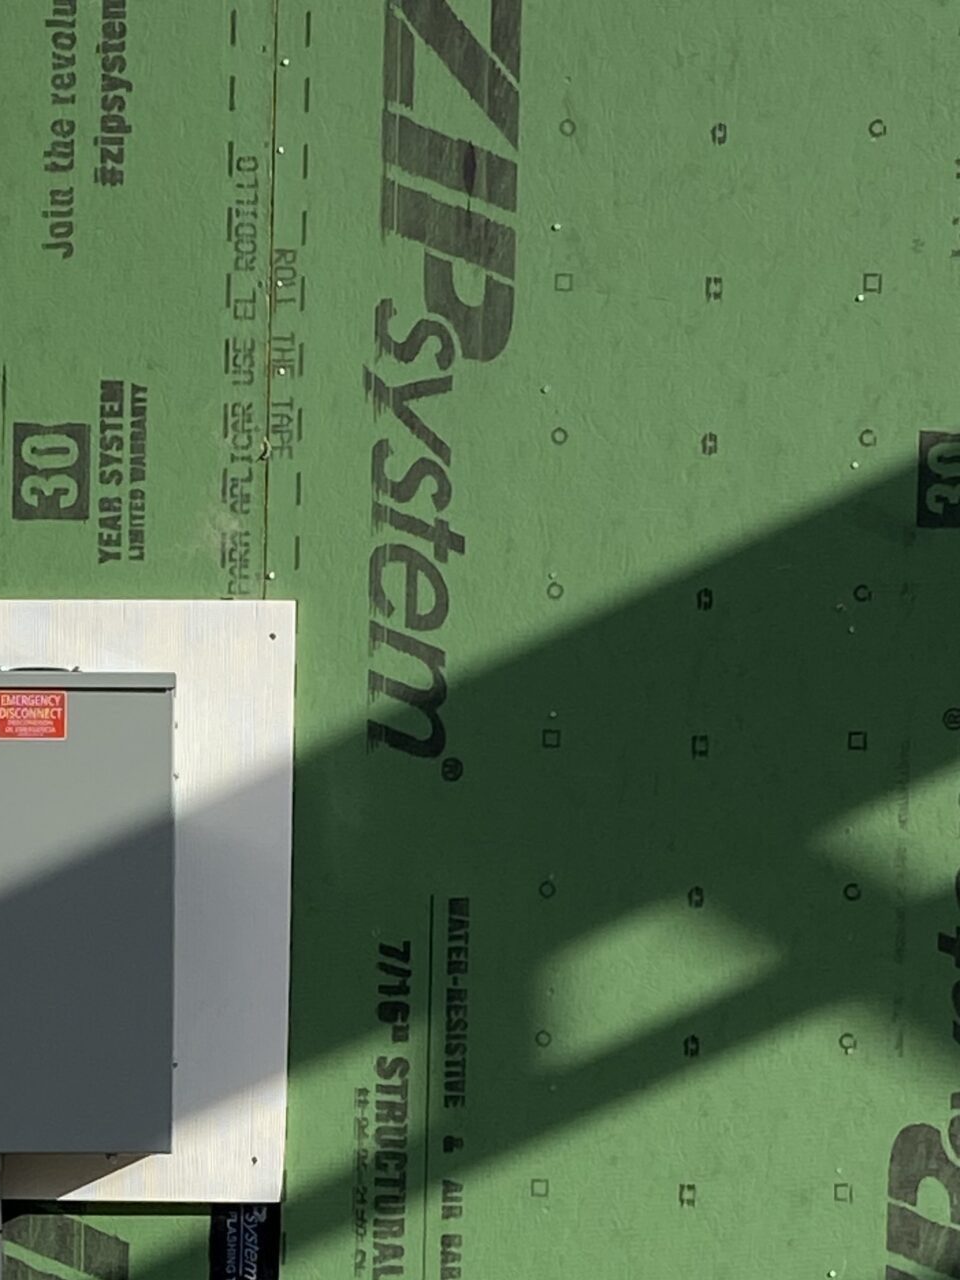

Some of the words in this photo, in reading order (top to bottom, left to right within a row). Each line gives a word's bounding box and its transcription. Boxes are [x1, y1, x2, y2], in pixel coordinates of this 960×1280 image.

[42, 118, 76, 174] the
[40, 186, 74, 260] Join
[234, 155, 260, 272] RODILLO
[232, 288, 257, 321] EL
[231, 337, 256, 386] USE
[270, 331, 296, 380] THE
[98, 379, 126, 487] SYSTEM
[129, 382, 148, 484] WARRANTY
[229, 401, 254, 516] APLICAR
[269, 396, 294, 460] TAPE
[19, 432, 81, 510] 30
[97, 496, 123, 565] YEAR
[128, 488, 146, 562] LIMITED
[226, 530, 252, 596] PARA
[0, 694, 62, 706] EMERGENCY
[376, 940, 412, 1044] 7/16"
[443, 896, 470, 1109] WATER-RESISTIVE
[441, 1135, 464, 1154] &
[440, 1178, 464, 1221] AIR
[225, 1210, 239, 1274] FLASHING
